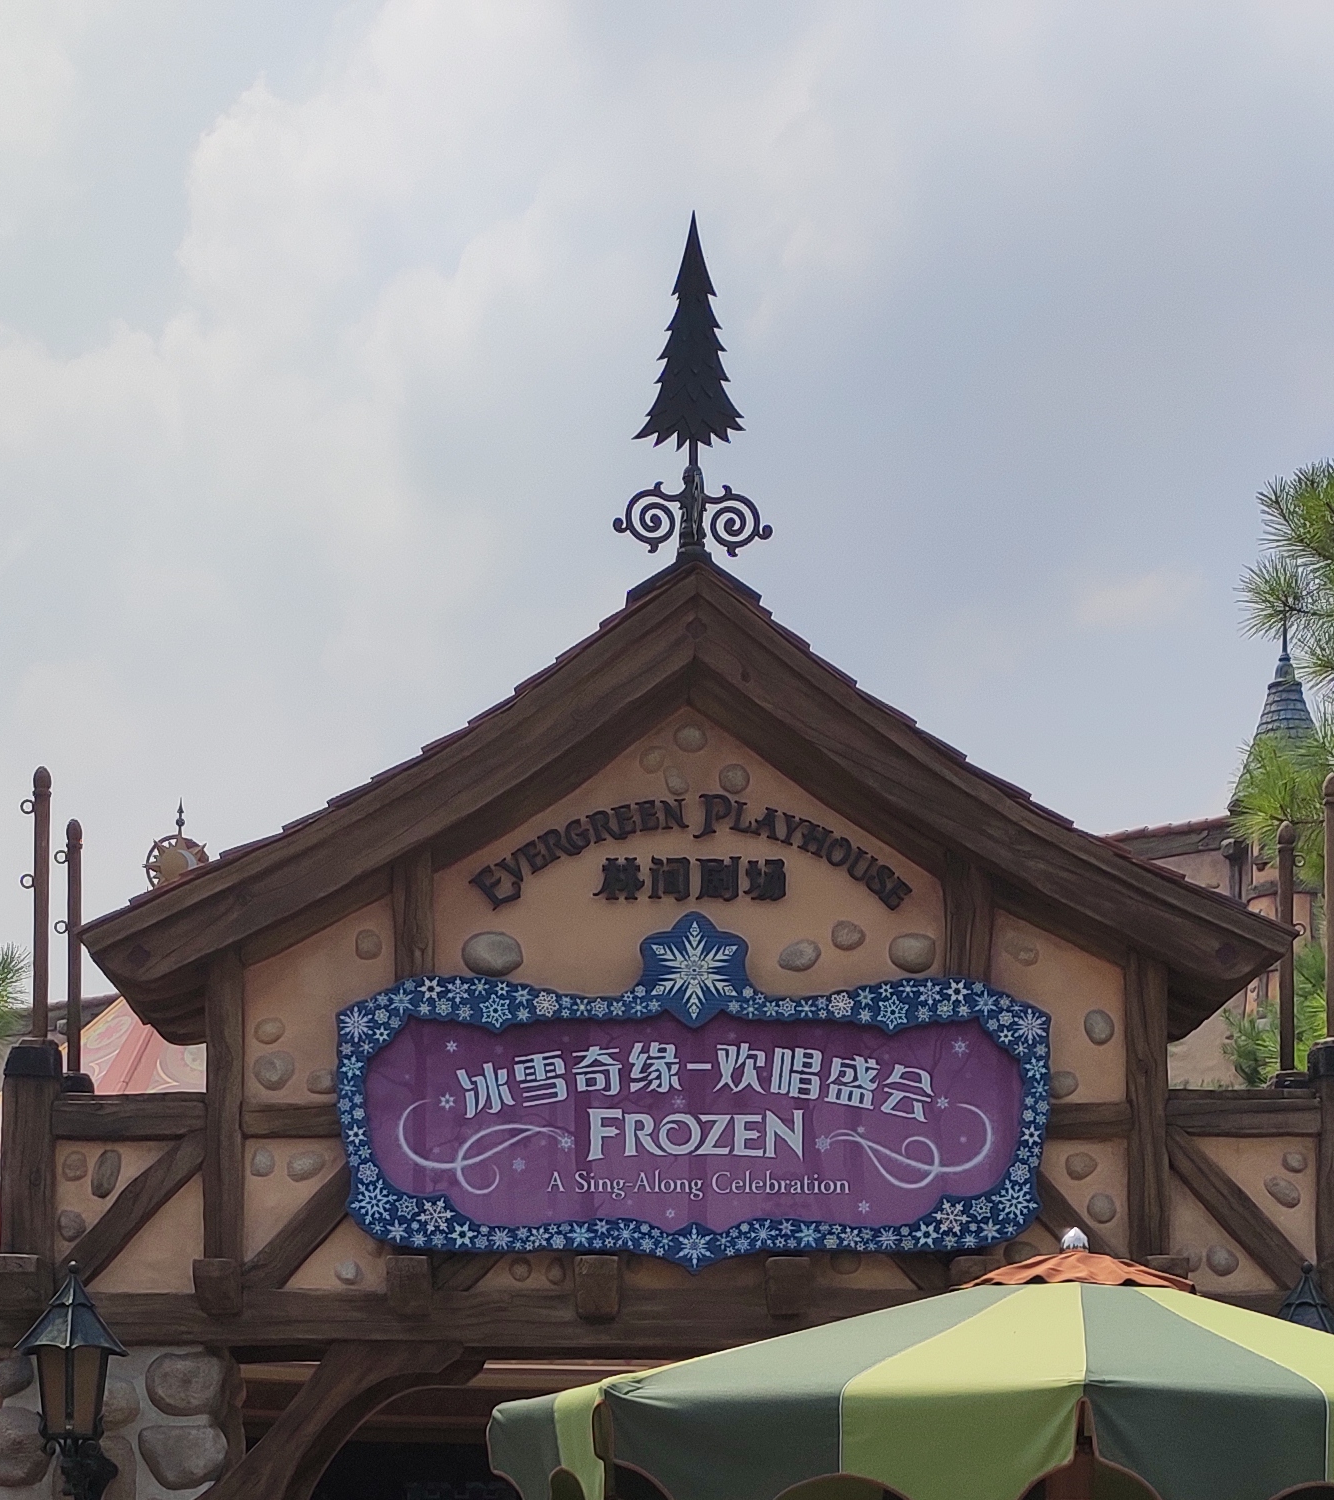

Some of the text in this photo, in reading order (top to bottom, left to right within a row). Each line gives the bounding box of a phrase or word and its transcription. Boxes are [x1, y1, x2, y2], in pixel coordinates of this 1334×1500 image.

[468, 793, 914, 912] EVERGREEN PLAYHOUSE
[592, 855, 787, 902] 林间剧场
[585, 1107, 805, 1162] FROZEN
[547, 1169, 851, 1200] A Sing-Along Celebration
